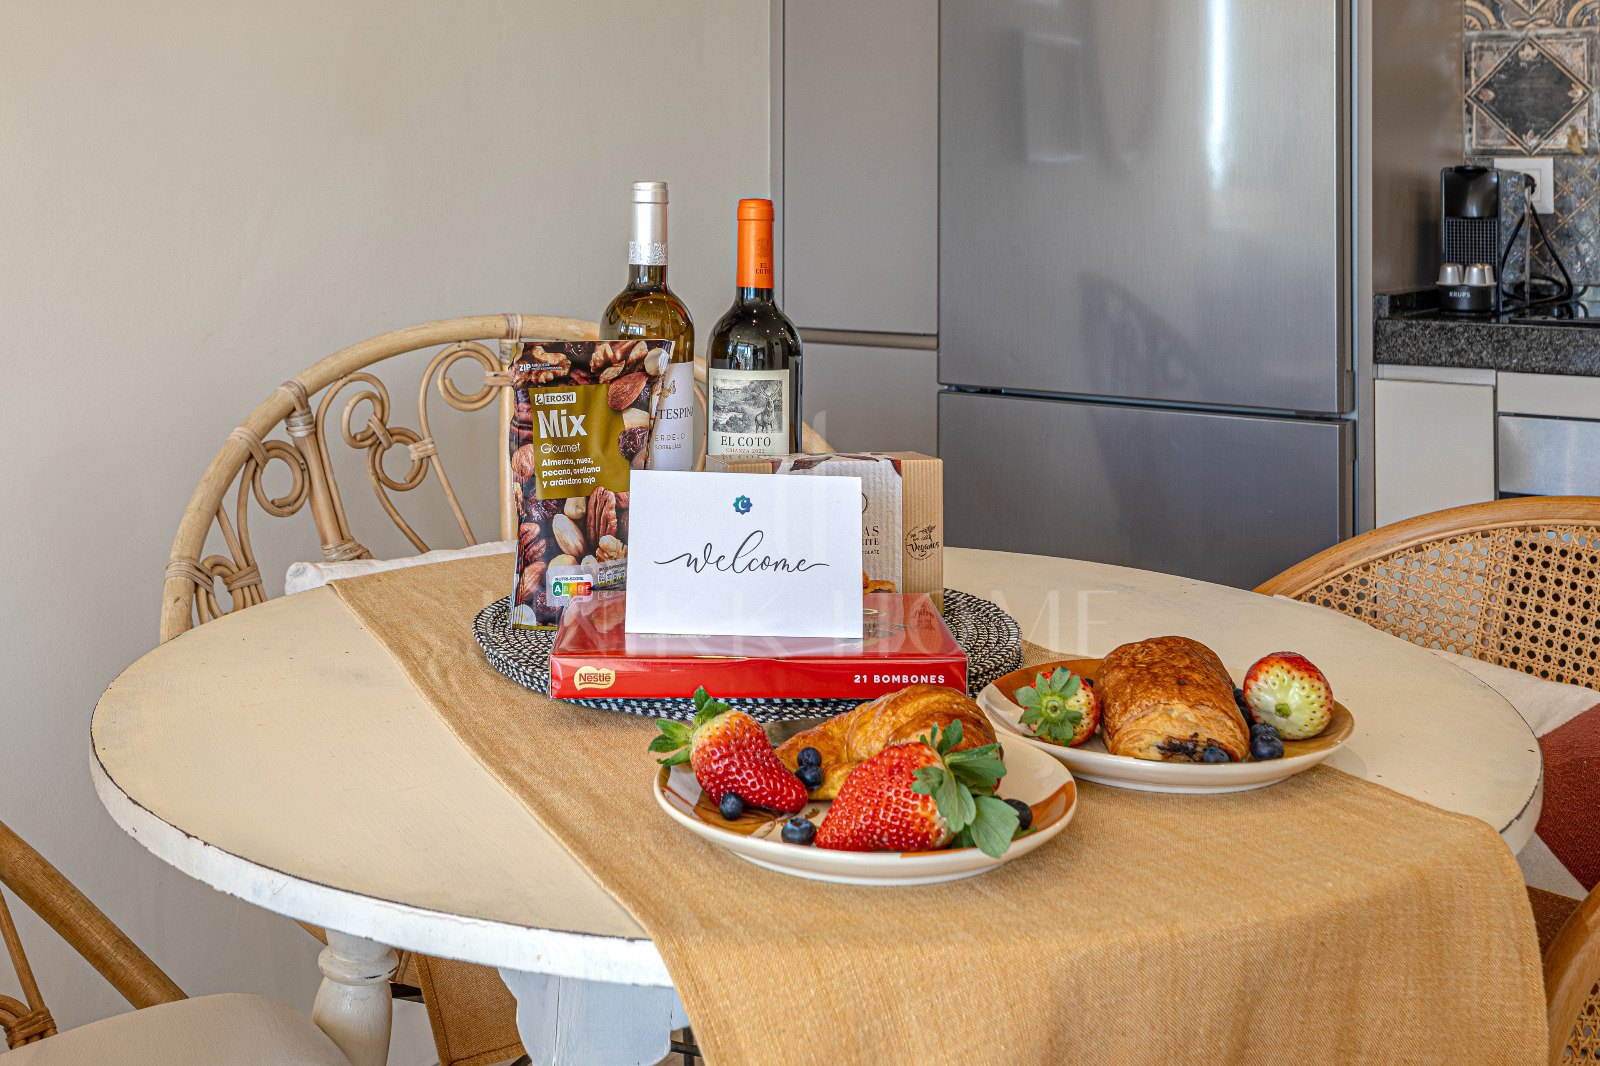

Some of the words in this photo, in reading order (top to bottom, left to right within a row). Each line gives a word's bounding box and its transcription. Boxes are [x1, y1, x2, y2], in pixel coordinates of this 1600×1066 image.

[1449, 290, 1471, 298] KRUPS
[518, 363, 532, 372] ZIP
[546, 393, 574, 403] EROSKI
[536, 409, 588, 439] Mix
[721, 435, 735, 447] EL
[737, 436, 772, 447] COTO
[540, 442, 581, 454] Gourmet
[542, 480, 548, 489] y
[549, 477, 582, 487] arándano
[582, 476, 596, 485] rojo
[653, 529, 830, 574] welcome
[853, 674, 867, 684] 21
[873, 674, 945, 684] BOMBONES
